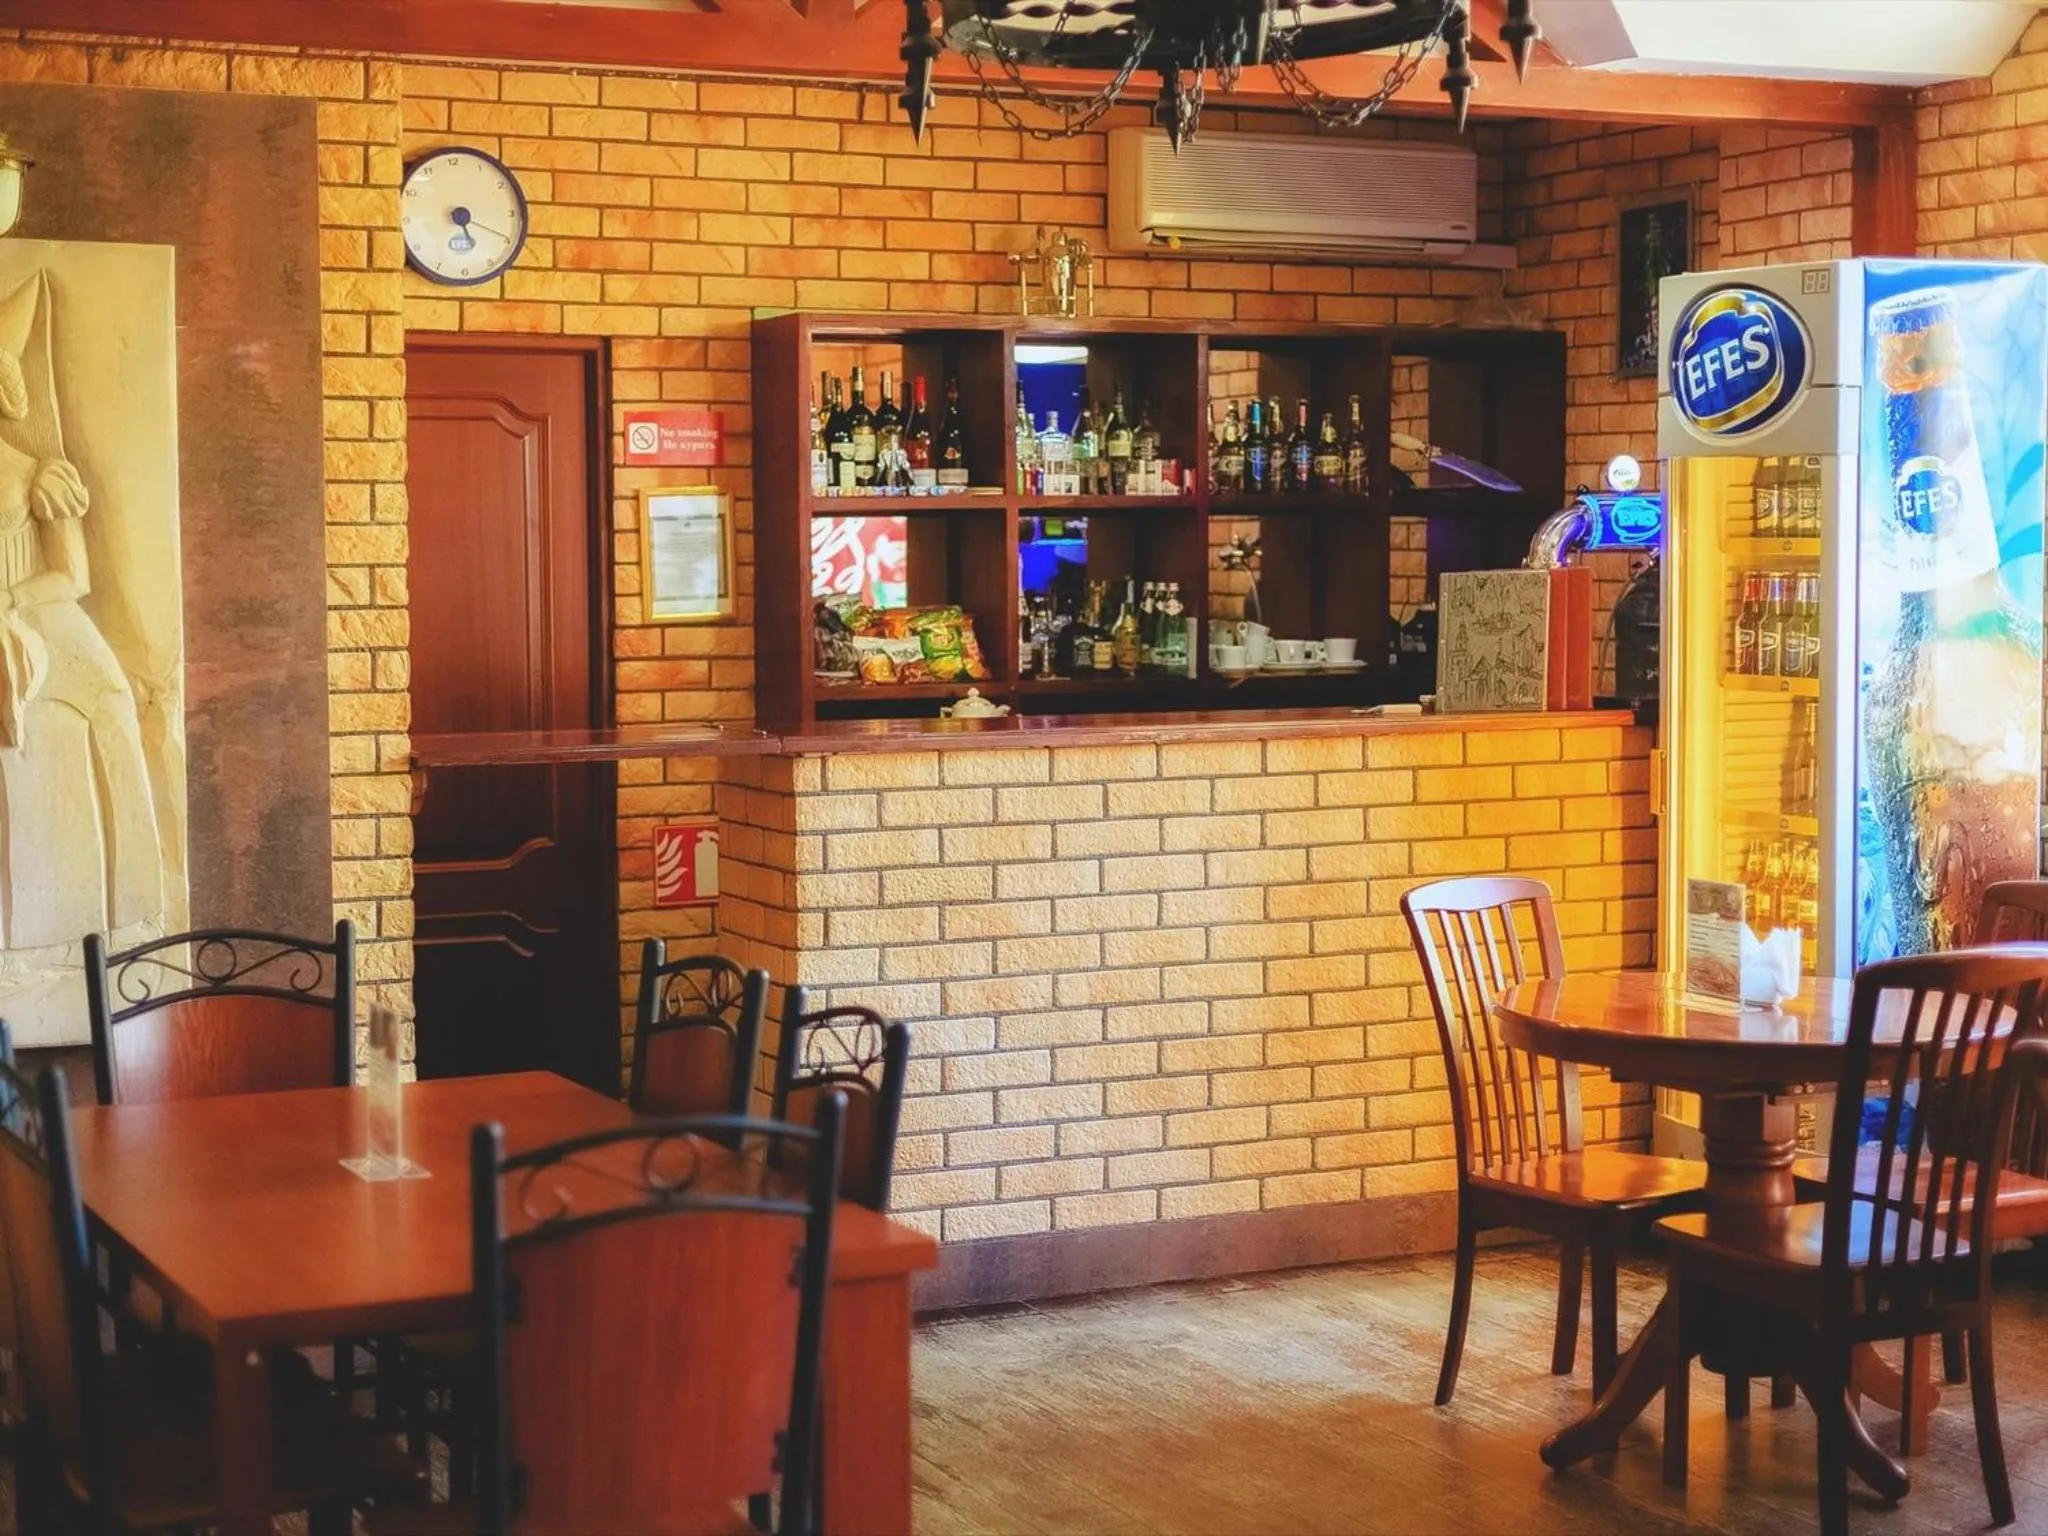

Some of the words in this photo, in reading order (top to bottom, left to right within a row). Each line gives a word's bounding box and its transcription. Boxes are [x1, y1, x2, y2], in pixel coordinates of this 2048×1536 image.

[448, 157, 459, 166] 12
[405, 188, 417, 197] 10
[1685, 323, 1770, 401] EFES
[660, 427, 675, 438] No
[1901, 480, 1960, 518] EFES
